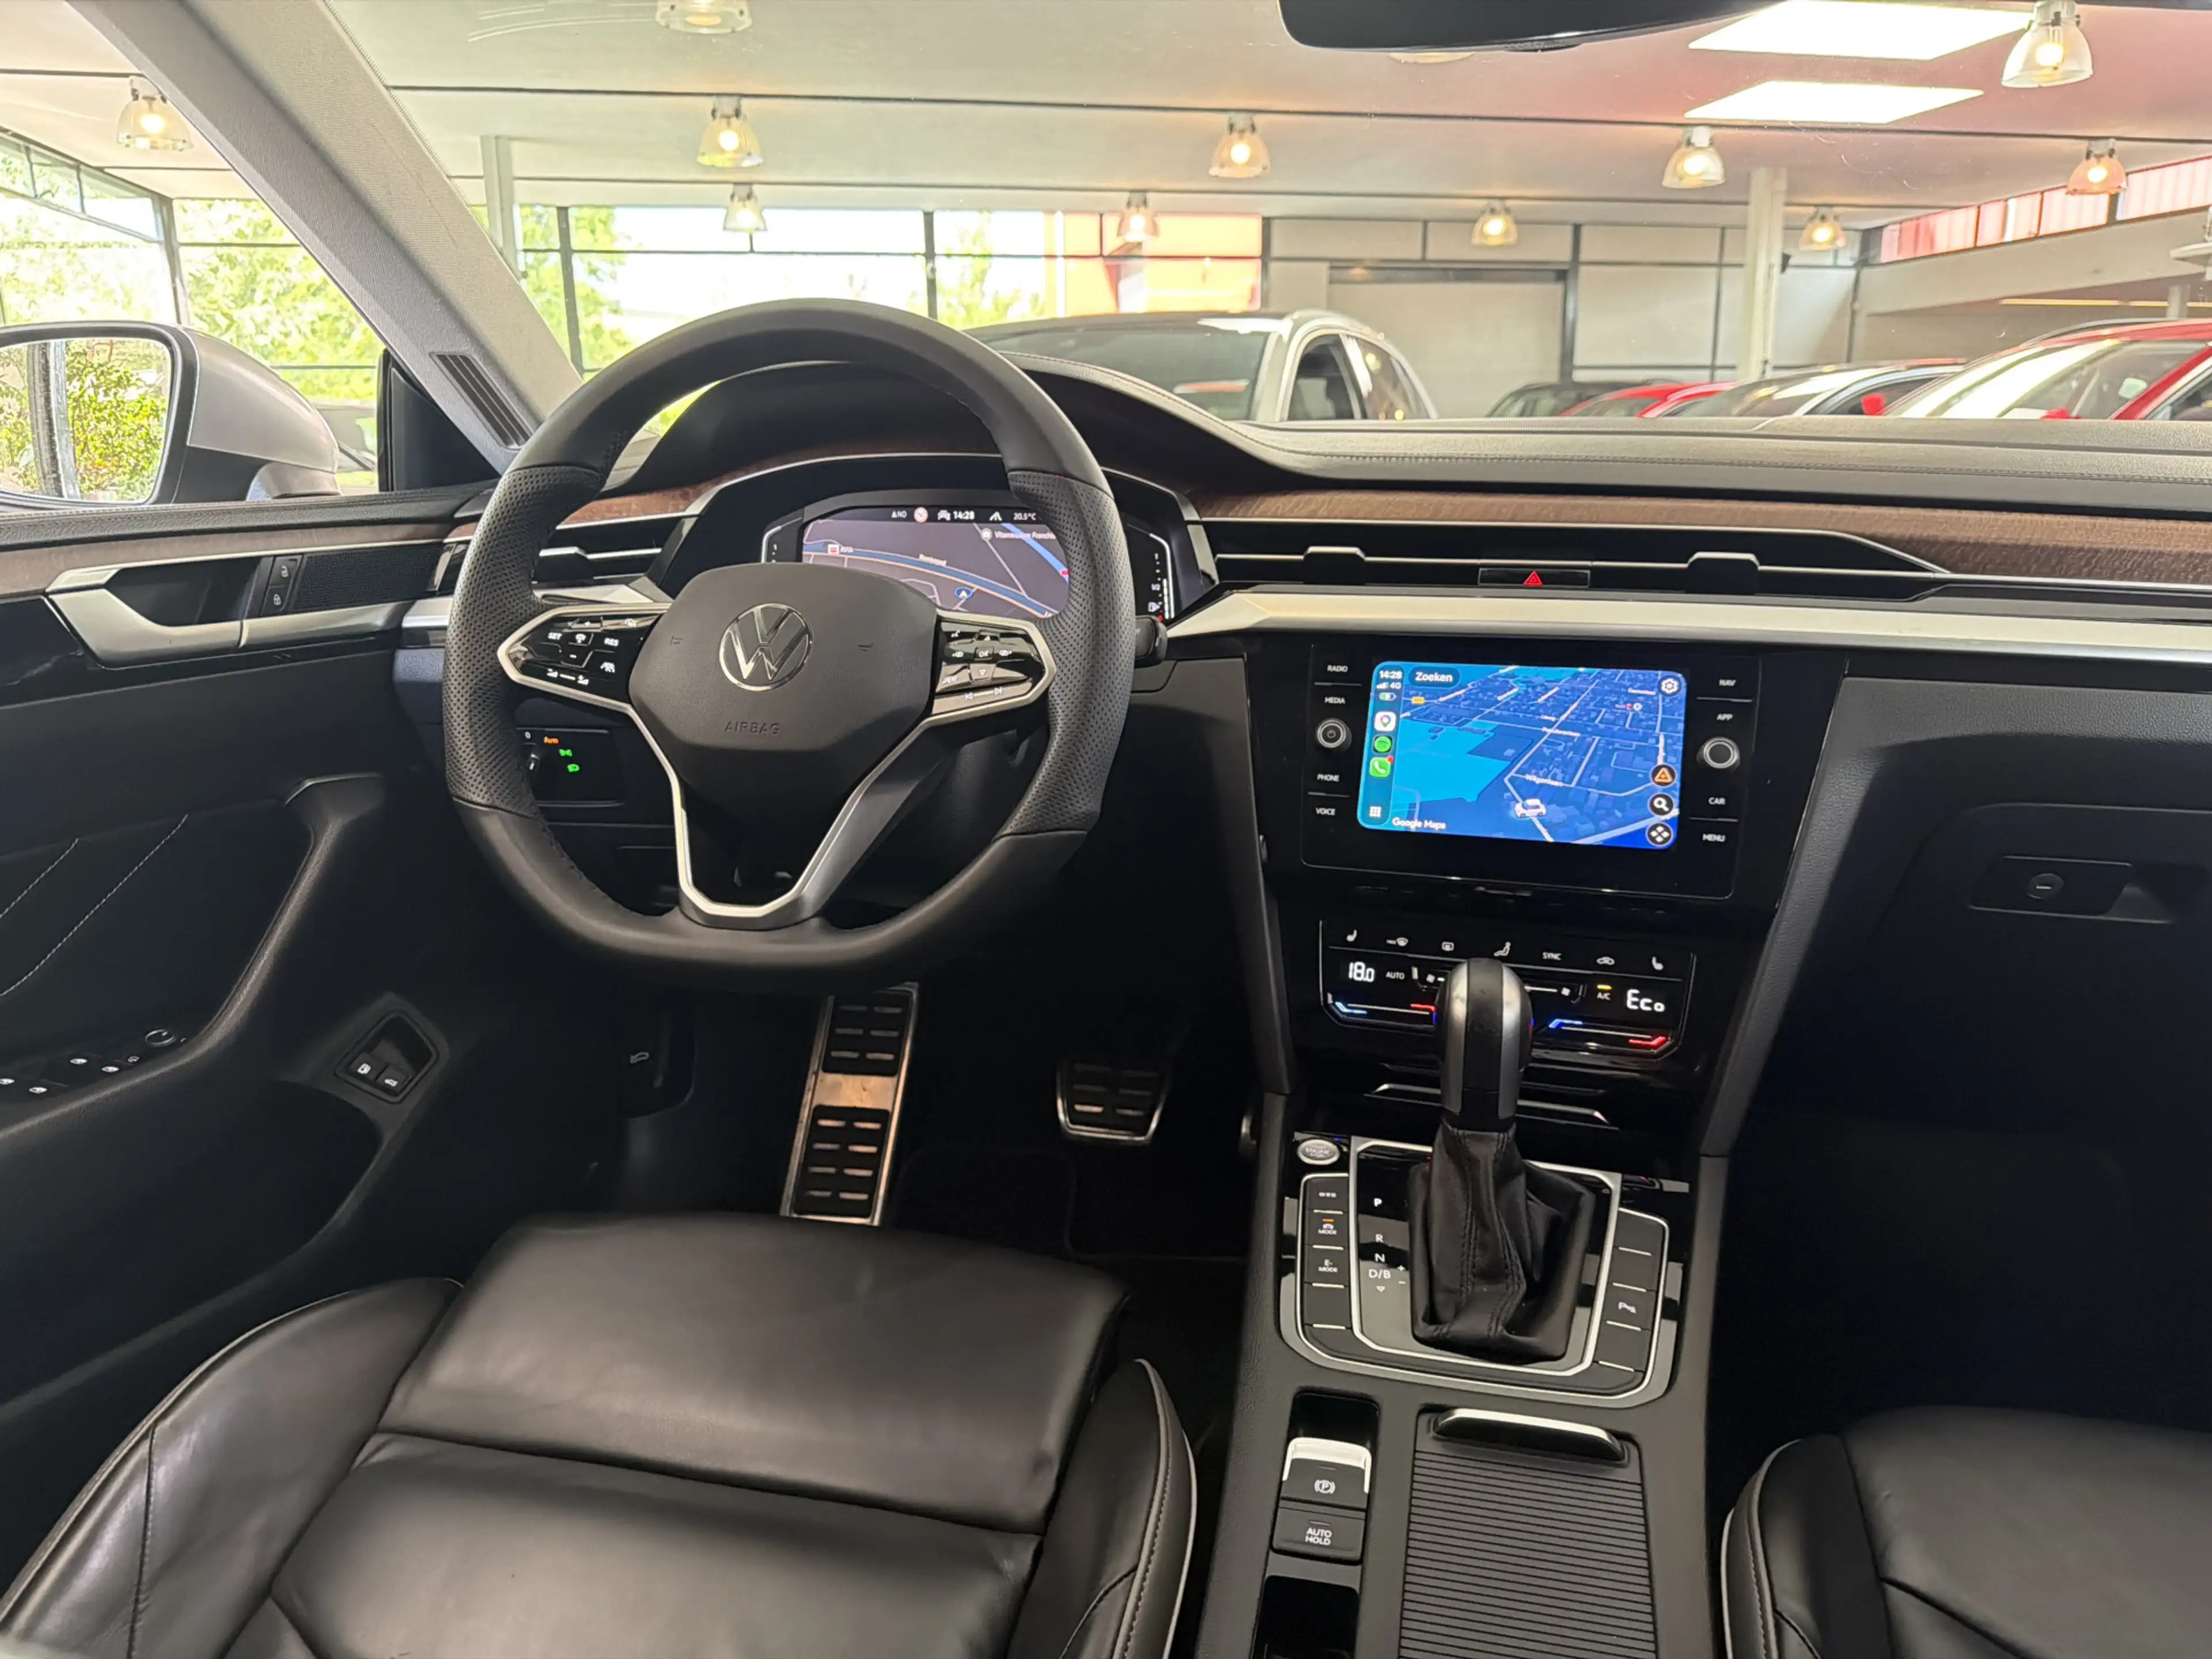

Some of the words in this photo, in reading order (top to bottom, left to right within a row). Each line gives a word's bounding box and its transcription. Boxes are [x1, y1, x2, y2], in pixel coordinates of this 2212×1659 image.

[953, 511, 975, 520] 14:28
[1013, 513, 1036, 521] 20.5°C
[547, 632, 563, 641] SET
[604, 637, 619, 647] RES
[1327, 664, 1349, 673] RADIO
[1379, 670, 1403, 680] 14:28
[1415, 671, 1453, 683] Zoeken
[1324, 696, 1346, 704] MEDIA
[1716, 713, 1733, 721] APP
[724, 721, 780, 735] AIRBAG
[1316, 774, 1340, 782] PHONE
[1708, 797, 1726, 805] CAR
[1315, 807, 1336, 816] VOICE
[1392, 817, 1423, 830] Google
[1424, 819, 1446, 830] Maps
[1702, 834, 1726, 842] MENU
[1542, 952, 1562, 961] SYNC
[1348, 961, 1375, 983] 18.0
[1385, 971, 1406, 980] AUTO
[1597, 991, 1611, 1001] A/C
[1626, 988, 1666, 1013] Eco
[1373, 1198, 1382, 1207] P
[1375, 1233, 1384, 1243] R
[1374, 1253, 1385, 1262] N
[1368, 1269, 1392, 1279] D/B
[1306, 1528, 1332, 1537] AUTO
[1305, 1536, 1331, 1546] HOLD
